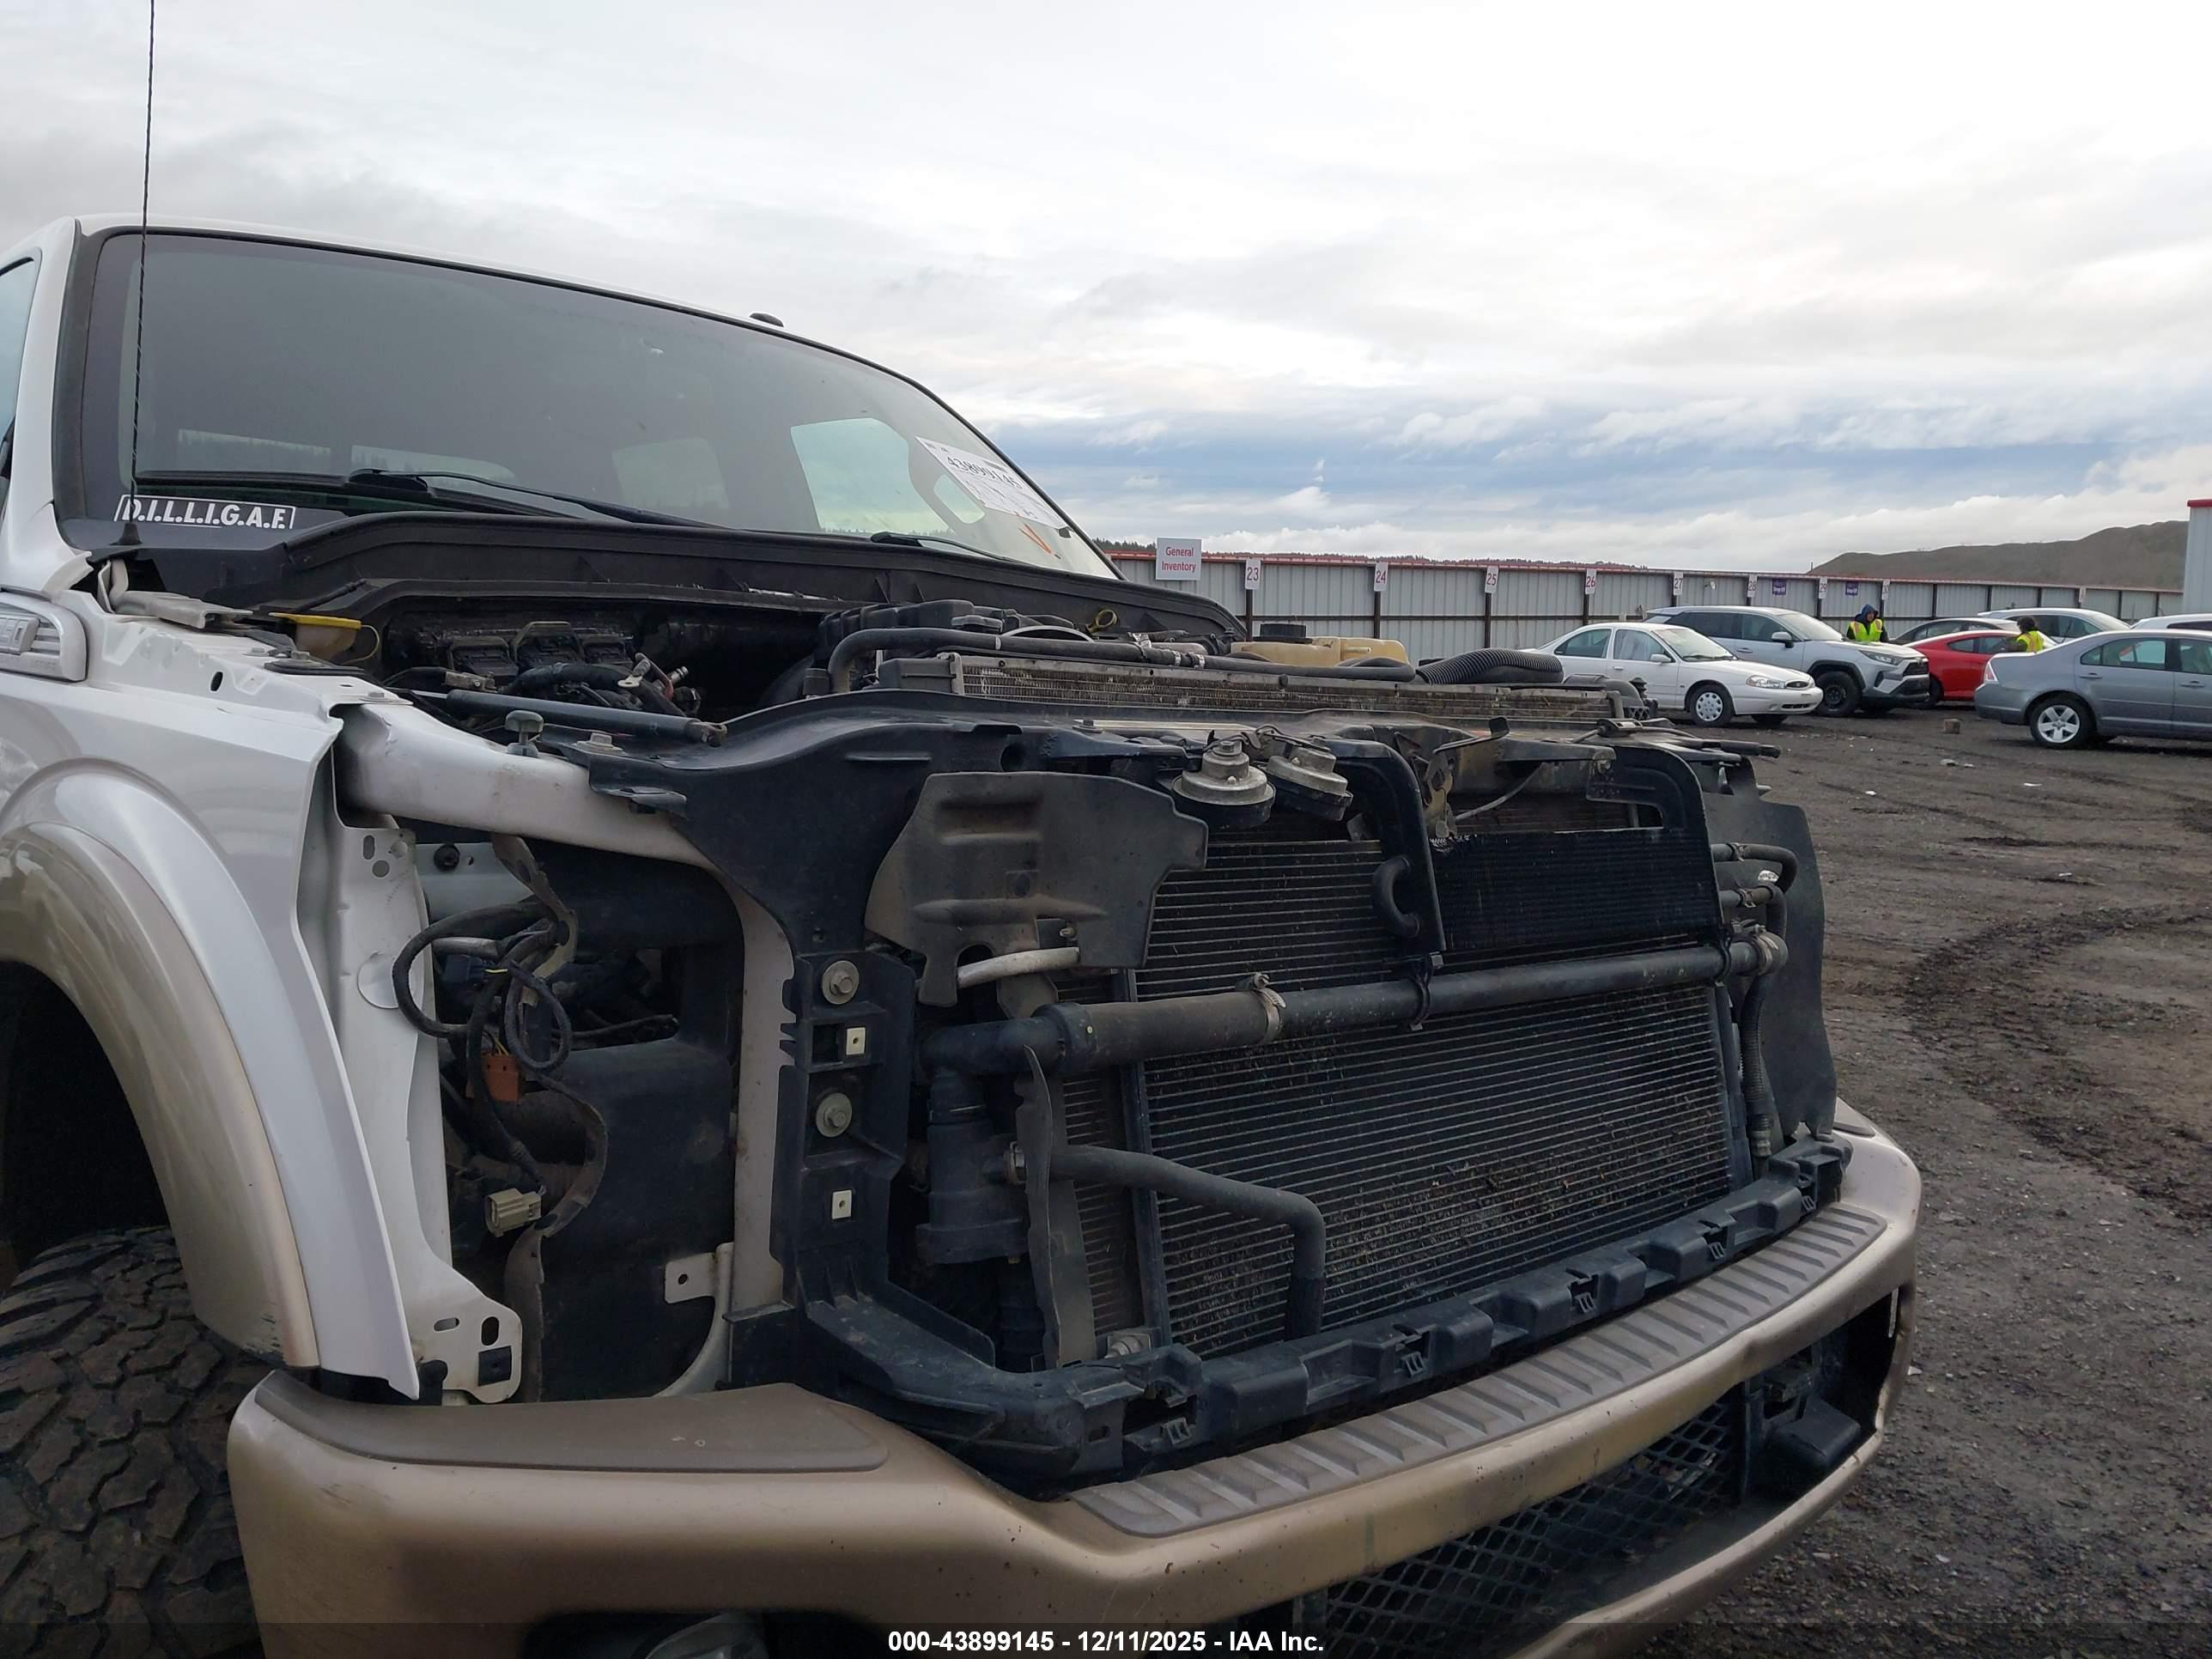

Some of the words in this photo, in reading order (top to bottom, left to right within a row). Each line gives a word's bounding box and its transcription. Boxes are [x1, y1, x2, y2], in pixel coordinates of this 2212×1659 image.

[121, 499, 286, 530] D.I.L.L.I.G.A.F.
[1165, 546, 1194, 557] General
[1162, 561, 1196, 573] Inventory
[1247, 567, 1259, 581] 23
[1376, 569, 1386, 584] 24
[1486, 573, 1497, 586] 25
[1585, 575, 1595, 587] 26
[1674, 577, 1683, 590] 27
[1748, 580, 1757, 592] 28
